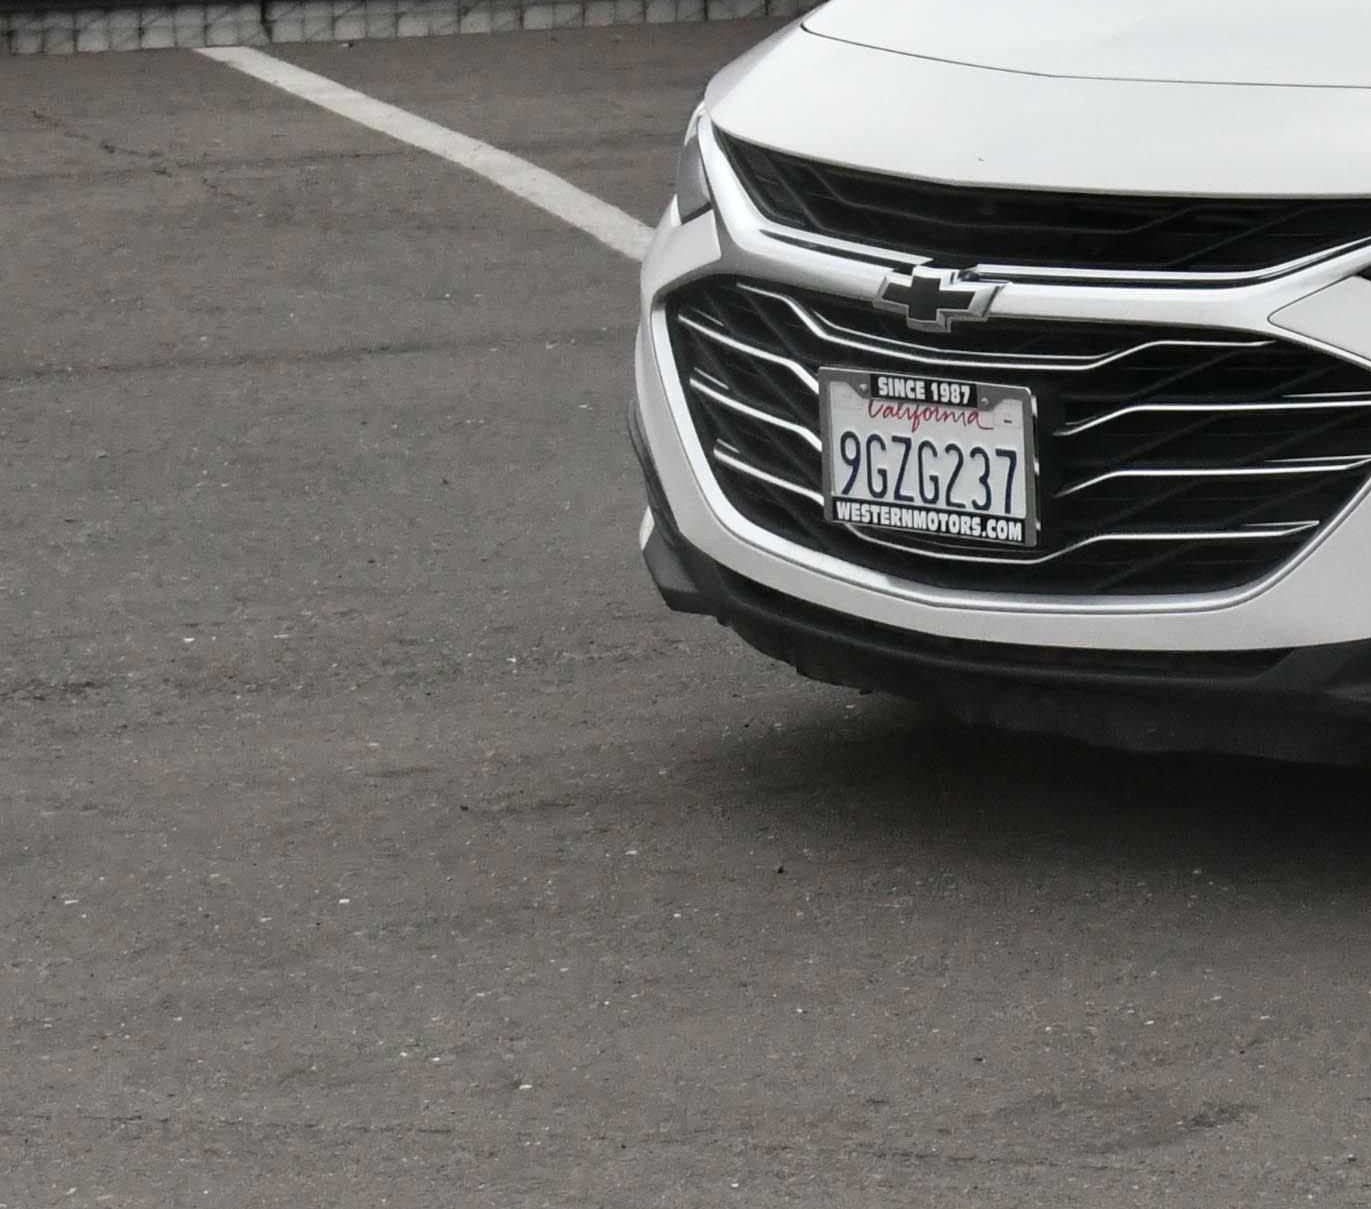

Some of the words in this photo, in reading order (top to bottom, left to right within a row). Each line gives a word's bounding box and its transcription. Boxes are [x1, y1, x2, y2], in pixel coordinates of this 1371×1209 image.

[877, 376, 926, 400] SINCE
[930, 382, 971, 405] 1987
[867, 399, 995, 433] California
[839, 430, 1018, 515] 9GZG237
[835, 500, 1023, 542] WESTERNMOTORS.COM
